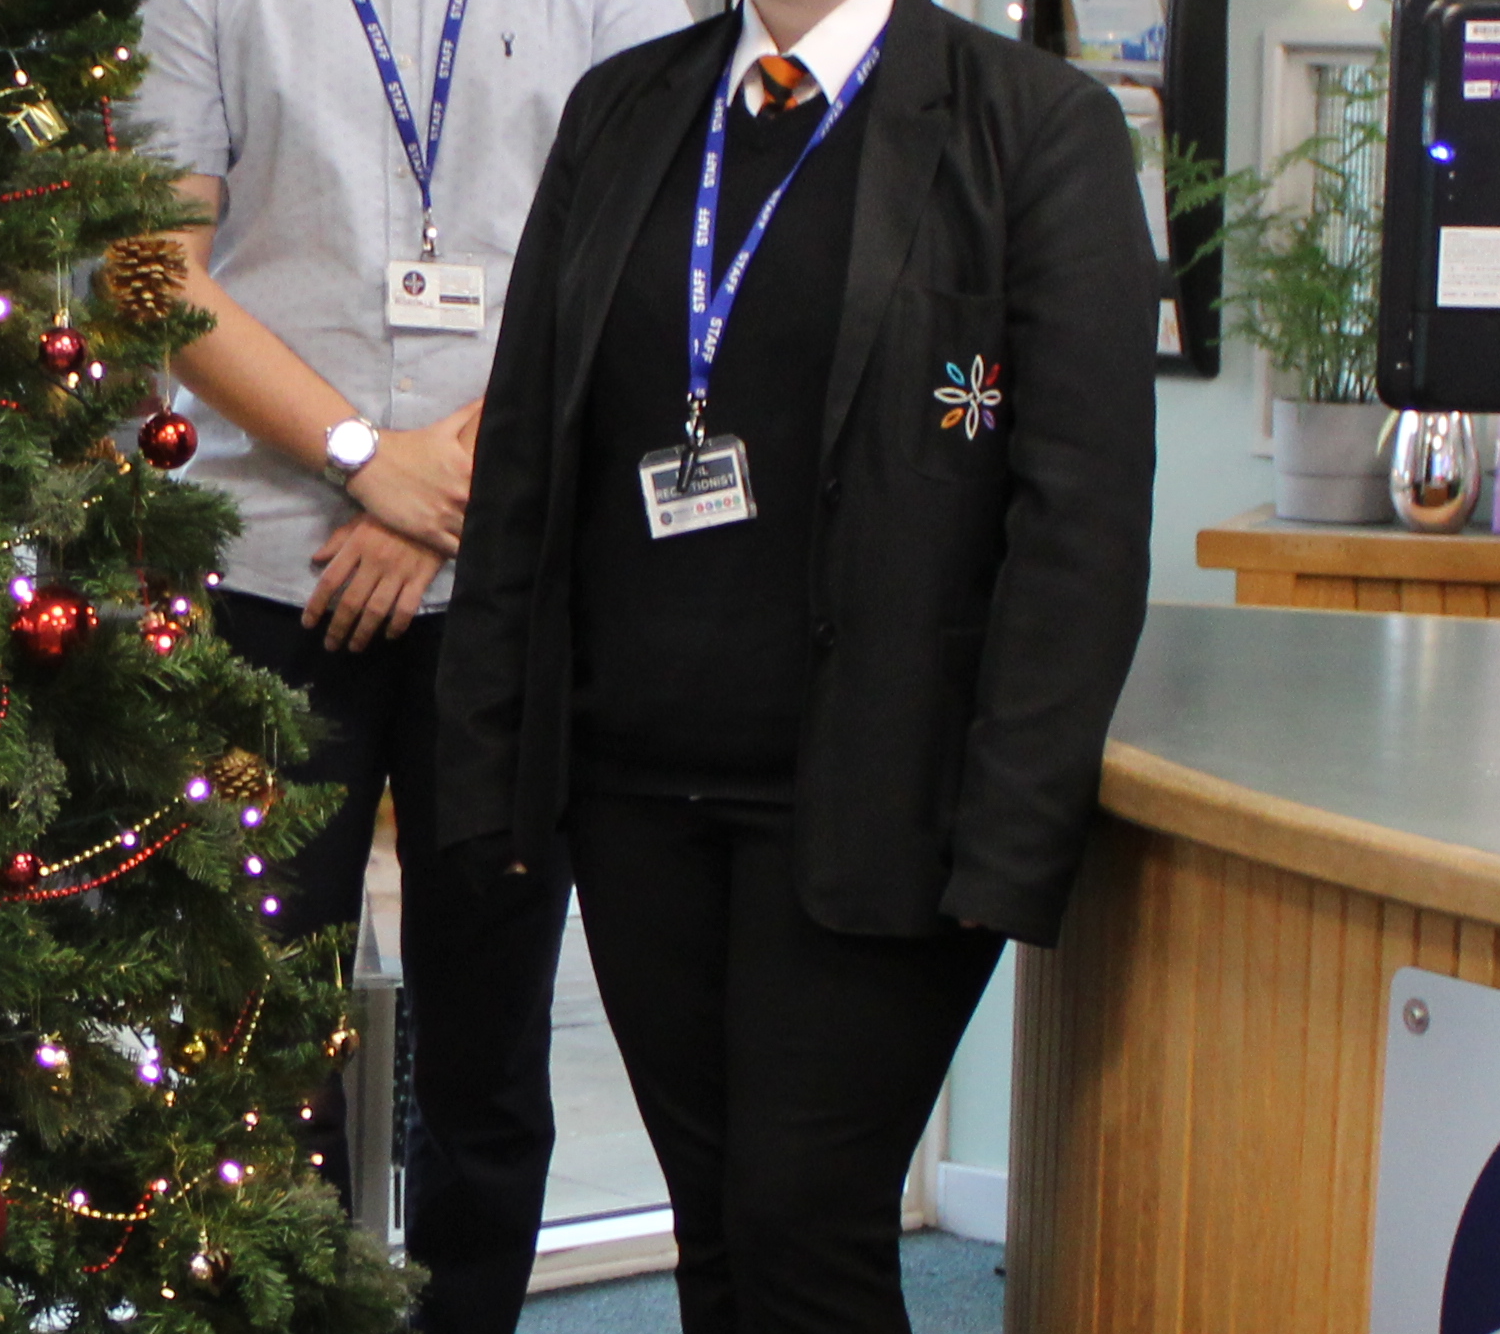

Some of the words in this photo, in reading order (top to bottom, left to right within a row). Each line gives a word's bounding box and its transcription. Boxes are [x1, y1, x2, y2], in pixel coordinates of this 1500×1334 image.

[366, 21, 390, 63] STAFF
[438, 39, 453, 79] STAFF
[388, 80, 409, 122] STAFF
[429, 101, 443, 143] STAFF
[696, 207, 711, 248] STAFF
[692, 269, 706, 314] STAFF
[702, 316, 723, 364] STAFF
